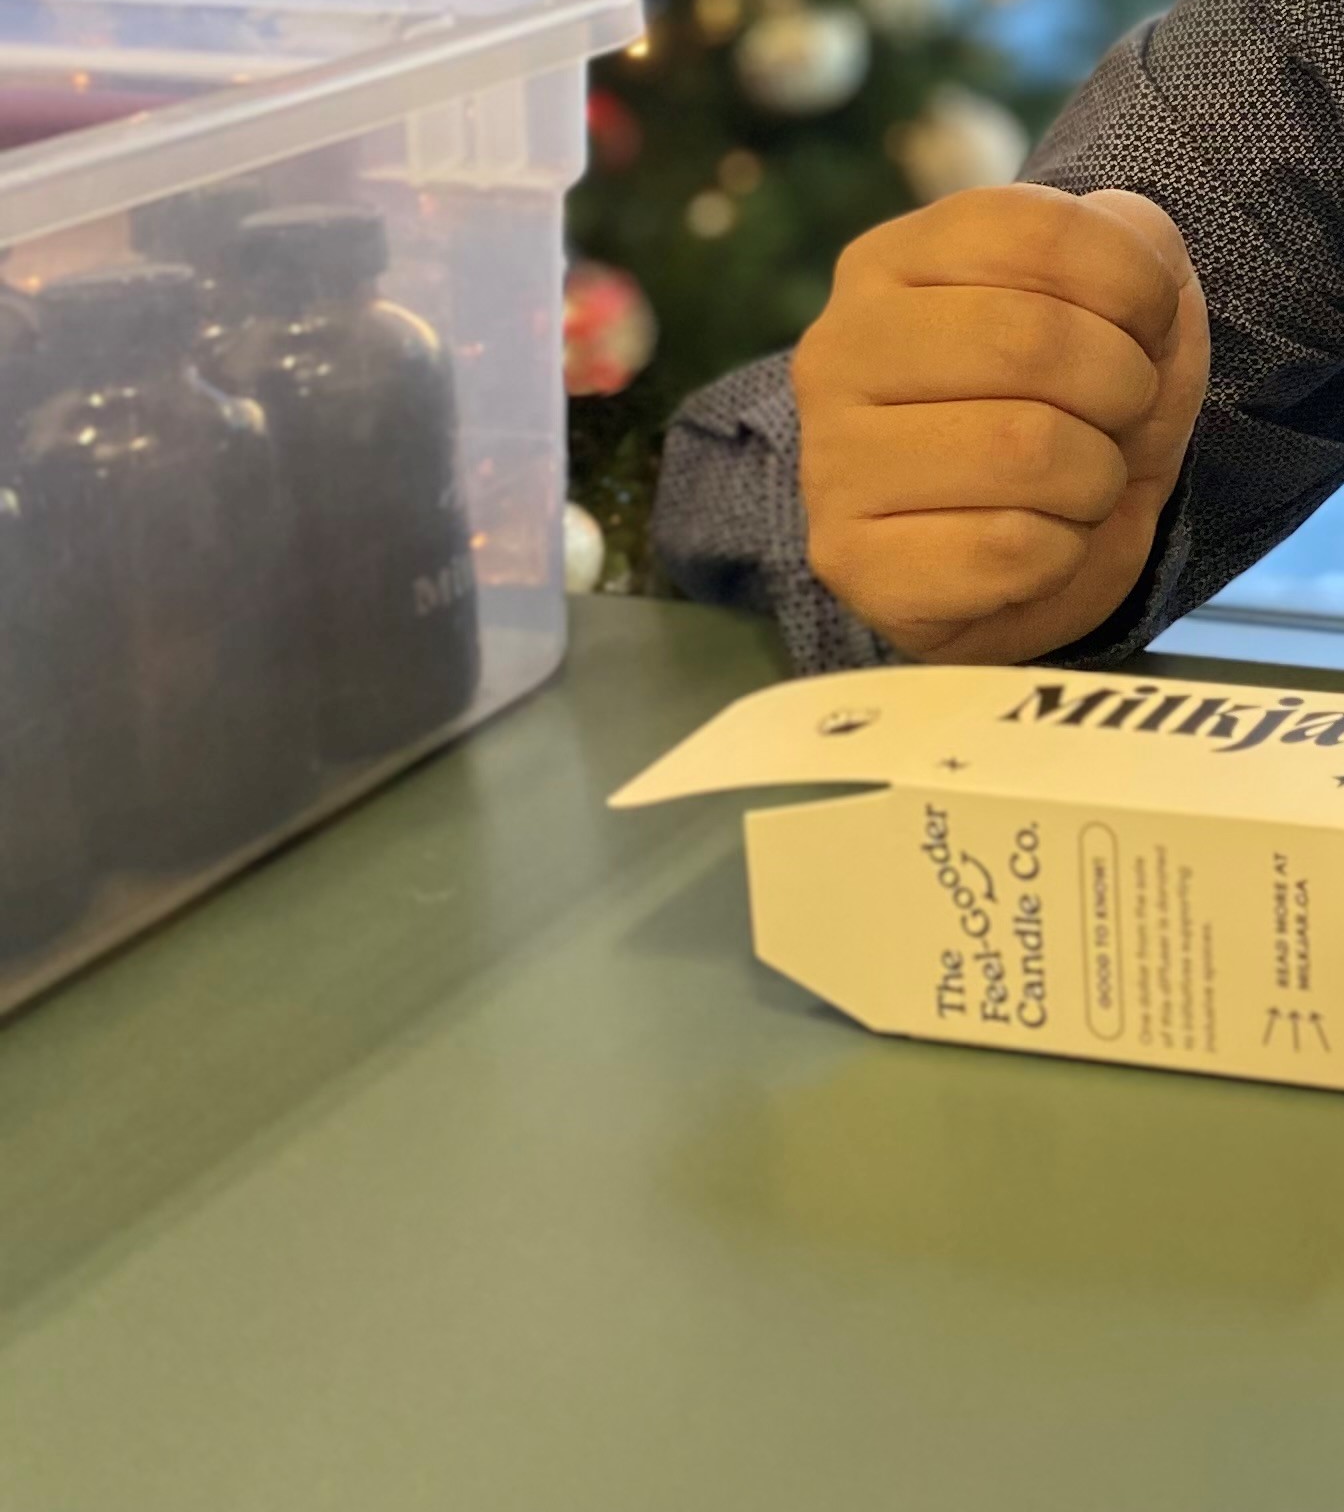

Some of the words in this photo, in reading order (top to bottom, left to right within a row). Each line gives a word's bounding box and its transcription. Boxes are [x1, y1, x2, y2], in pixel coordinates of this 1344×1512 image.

[1009, 822, 1040, 881] Co.
[1273, 852, 1288, 876] AT
[922, 803, 1011, 1024] Feel-Gooder
[1094, 924, 1109, 948] TO
[1273, 881, 1288, 935] MORE
[1294, 879, 1310, 990] MILKJAR.CA
[936, 949, 967, 1018] The
[1013, 893, 1047, 1029] Candle
[1096, 952, 1112, 1010] GOOD
[1274, 939, 1290, 989] READ
